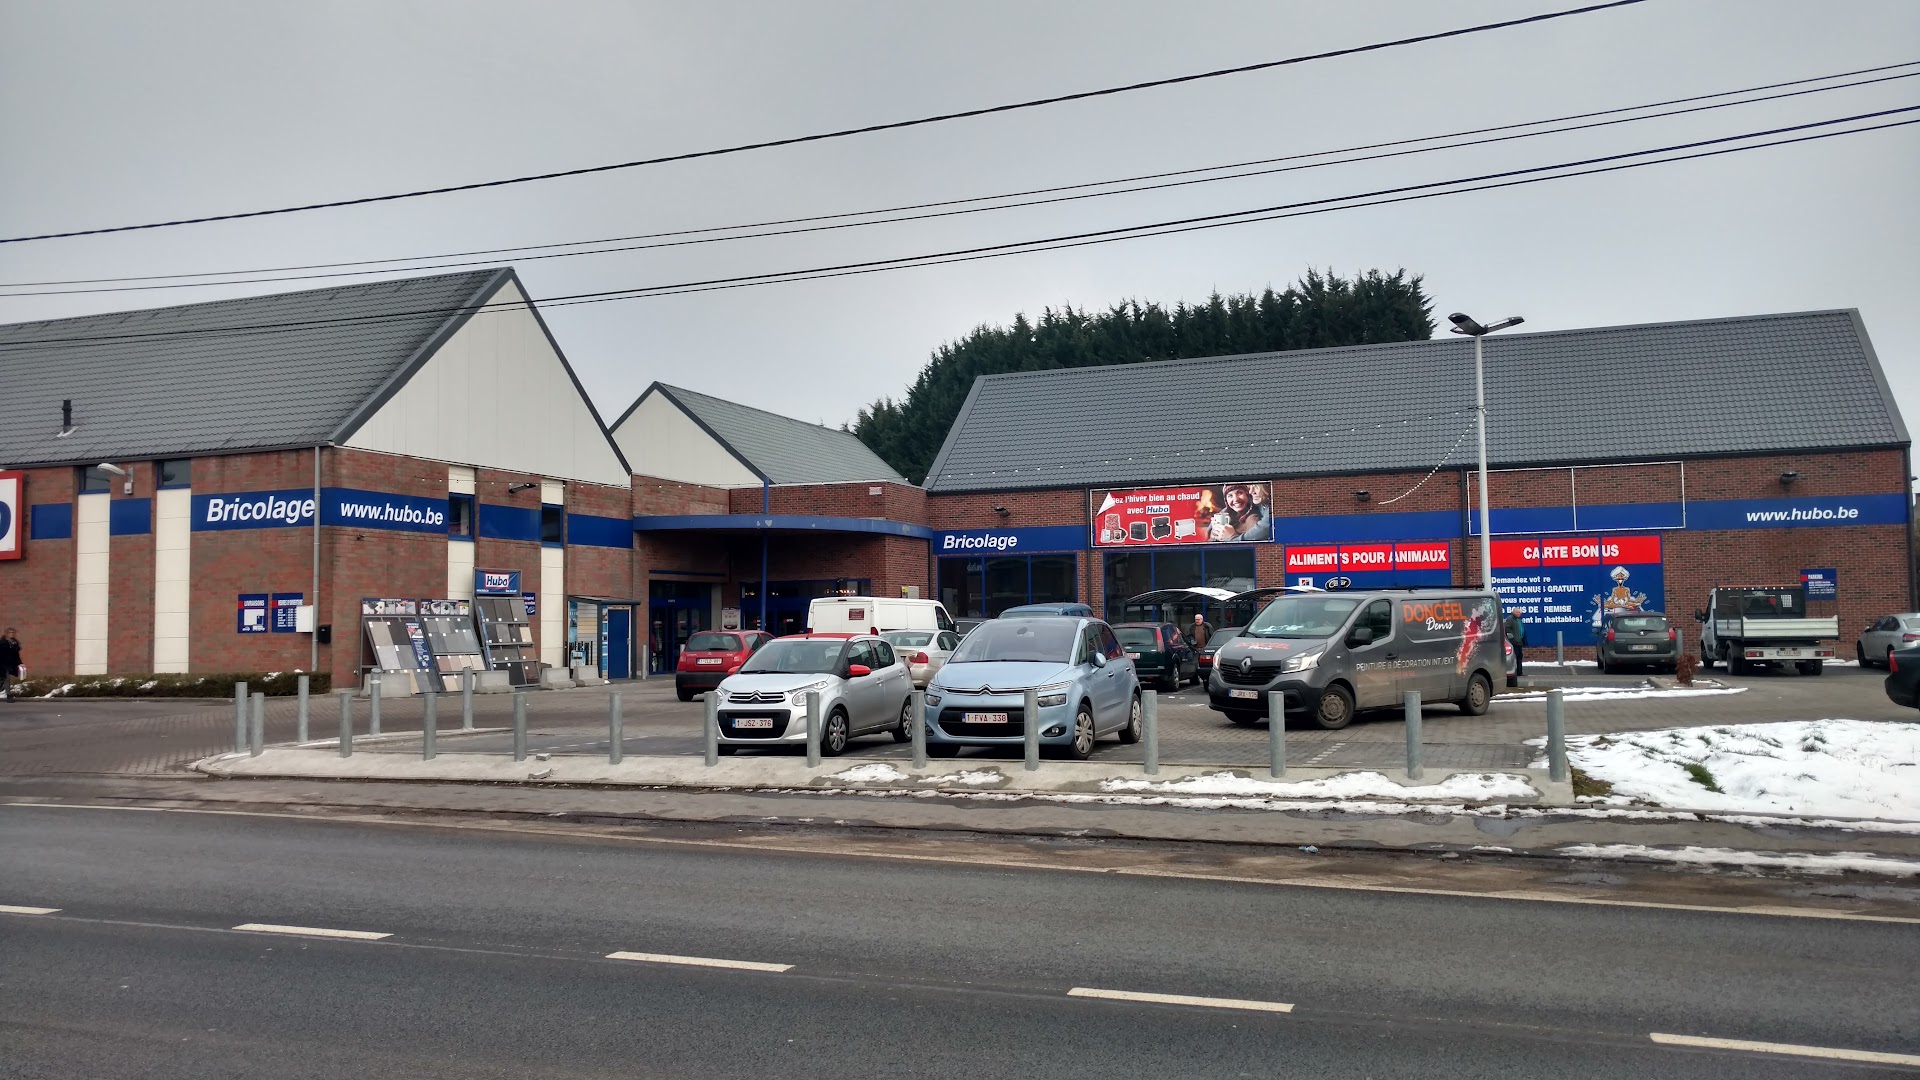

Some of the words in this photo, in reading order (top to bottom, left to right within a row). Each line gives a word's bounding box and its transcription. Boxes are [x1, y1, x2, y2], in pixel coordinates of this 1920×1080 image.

[1125, 494, 1148, 503] l'hiver
[1149, 494, 1165, 502] bien
[1177, 492, 1200, 501] chaud
[207, 495, 315, 524] Bricolage
[340, 502, 444, 526] www.hubo.be
[1746, 506, 1859, 522] www.hubo.be
[943, 533, 1018, 551] Bricolage
[1289, 552, 1349, 566] ALIMENTS
[1352, 551, 1386, 564] POUR
[1388, 549, 1447, 563] ANIMAUX
[1523, 546, 1568, 560] CARTE
[1572, 544, 1619, 558] BONUS
[486, 575, 508, 586] Hubo
[1491, 576, 1528, 584] Demandez
[1491, 586, 1516, 594] CARTE
[1548, 585, 1584, 593] GRATUITE
[1403, 602, 1467, 623] DONCEEL
[1528, 605, 1539, 613] DE
[1543, 605, 1572, 613] REMISE
[1425, 616, 1454, 631] Denis
[1356, 660, 1387, 672] PEINTURE
